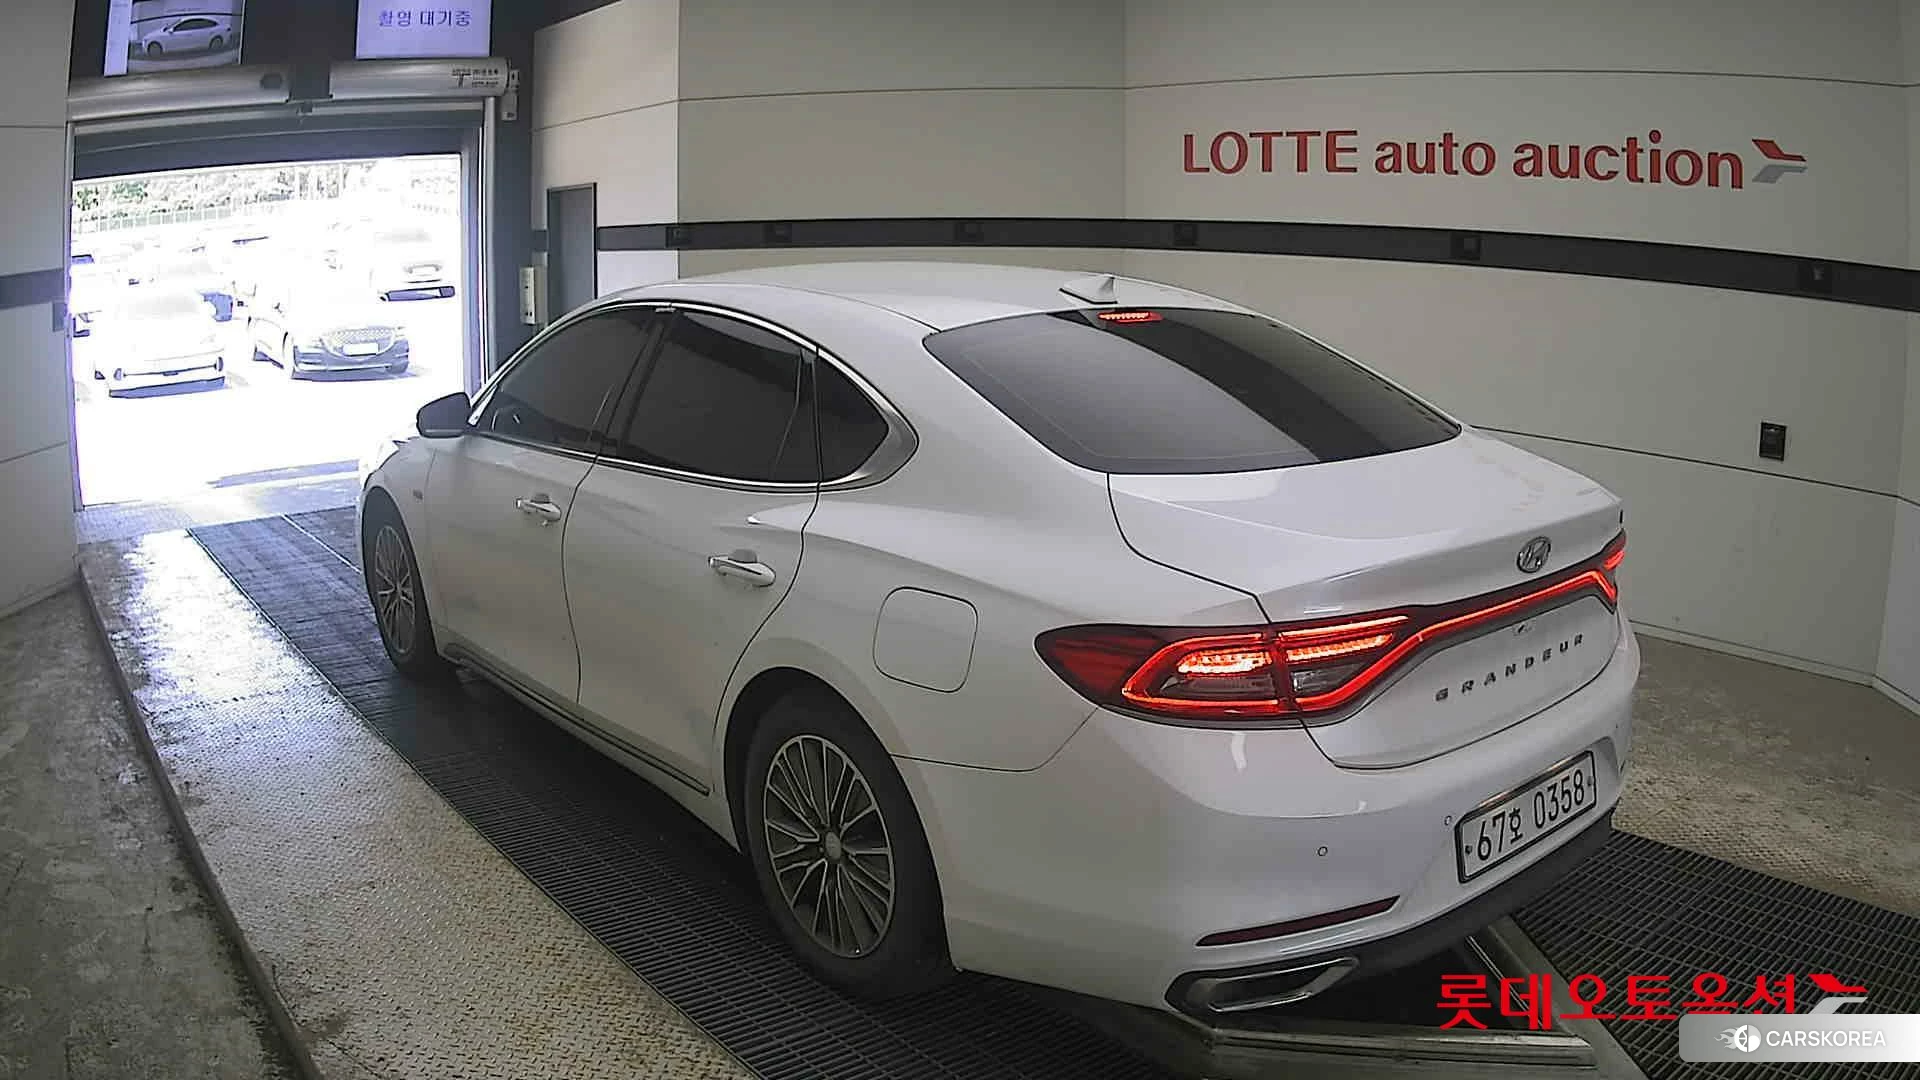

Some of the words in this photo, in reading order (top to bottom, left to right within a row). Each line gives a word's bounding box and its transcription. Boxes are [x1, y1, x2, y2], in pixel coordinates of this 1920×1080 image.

[420, 9, 471, 27] 대기중
[1184, 130, 1358, 174] LOTTE
[1375, 131, 1496, 177] auto
[1512, 129, 1744, 189] auction
[1435, 633, 1584, 702] GRANDEUR
[1477, 808, 1523, 861] 67호
[1534, 769, 1585, 829] 0358
